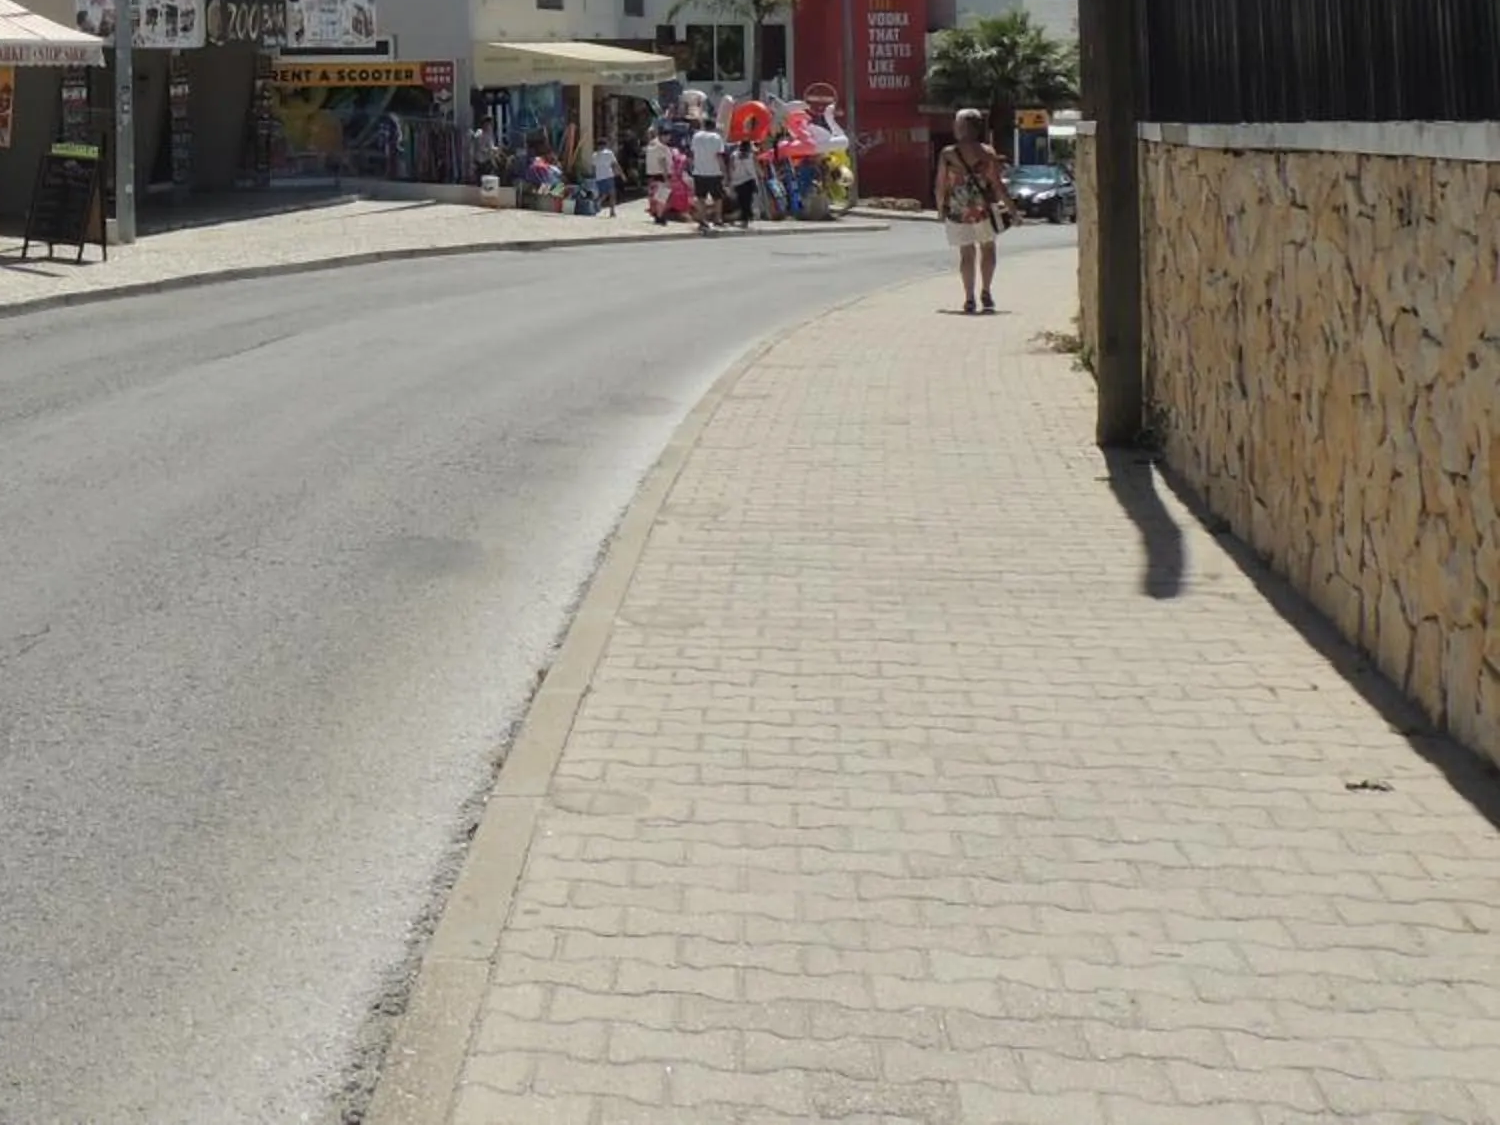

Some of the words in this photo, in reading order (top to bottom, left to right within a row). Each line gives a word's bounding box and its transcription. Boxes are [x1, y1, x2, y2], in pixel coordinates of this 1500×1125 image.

[867, 12, 909, 26] VODKA
[868, 28, 900, 42] THAT
[868, 43, 912, 58] TASTES
[867, 60, 895, 74] LIKE
[271, 69, 312, 82] RENT
[317, 69, 331, 82] A
[336, 69, 414, 83] SCOOTER
[868, 75, 911, 89] VODKA
